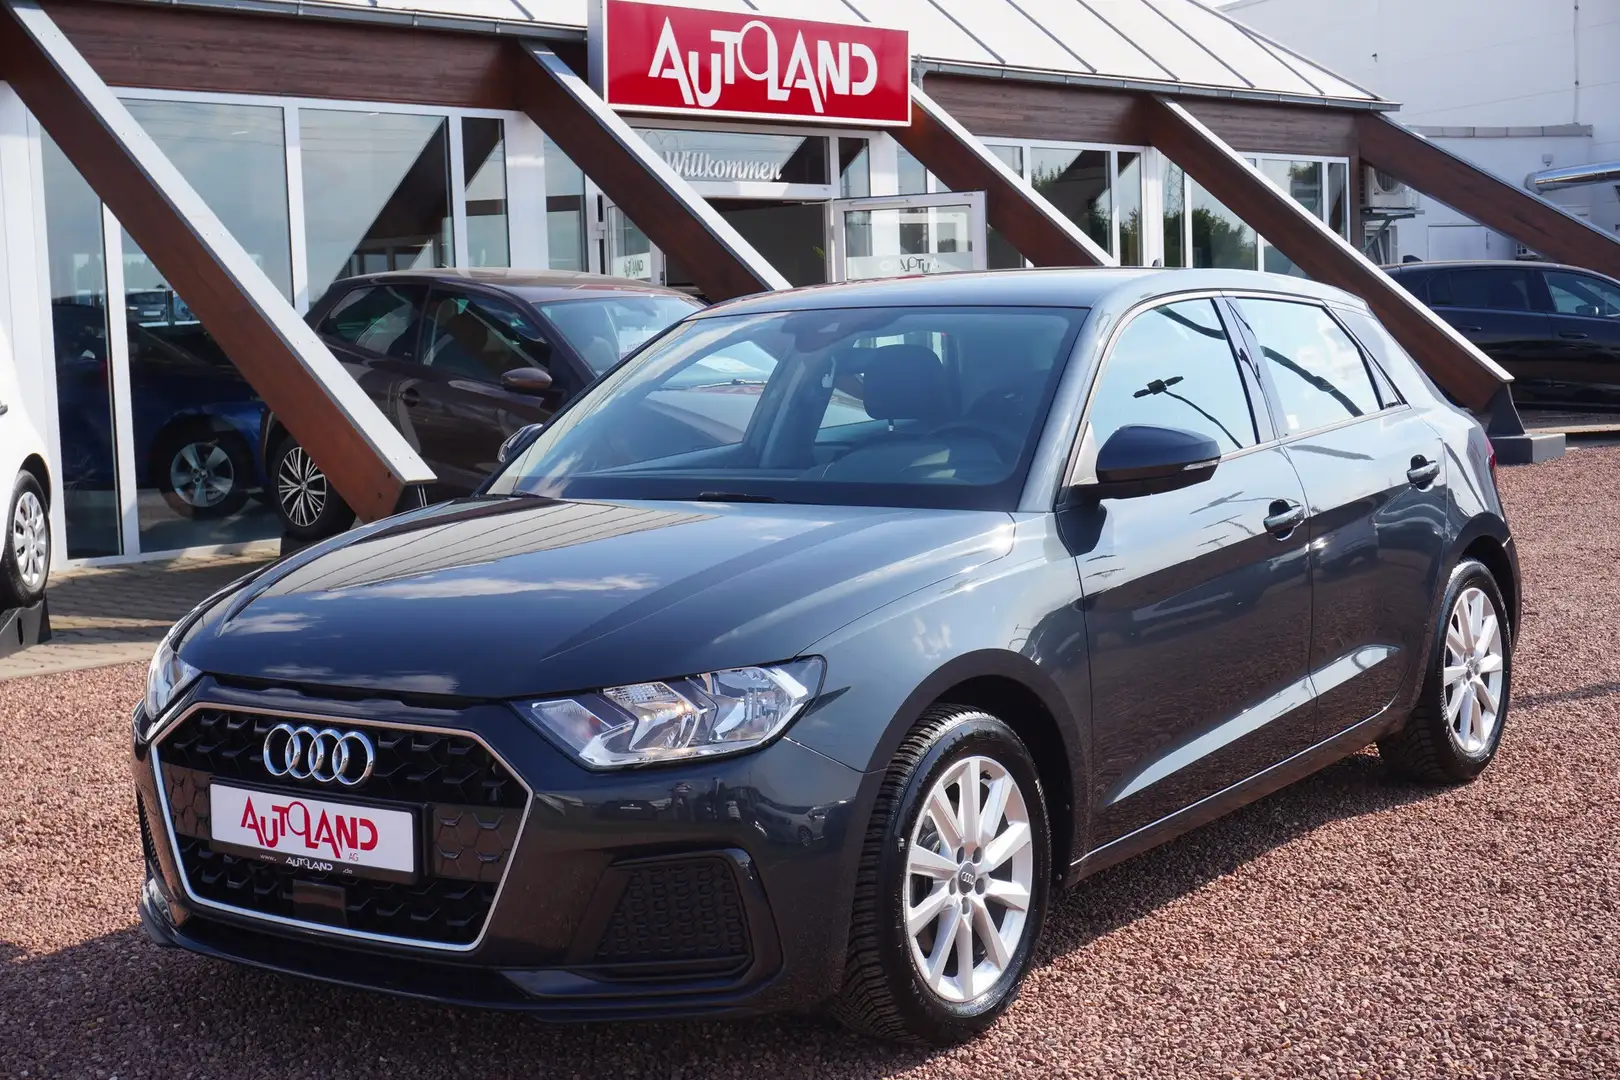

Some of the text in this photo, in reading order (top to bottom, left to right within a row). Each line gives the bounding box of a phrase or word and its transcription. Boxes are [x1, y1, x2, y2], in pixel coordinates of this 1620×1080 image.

[648, 16, 878, 113] AUTOLAND
[664, 151, 782, 180] Willkommen
[240, 796, 378, 858] AUTOLAND
[286, 857, 333, 871] AUTOLAND
[348, 852, 359, 862] AG
